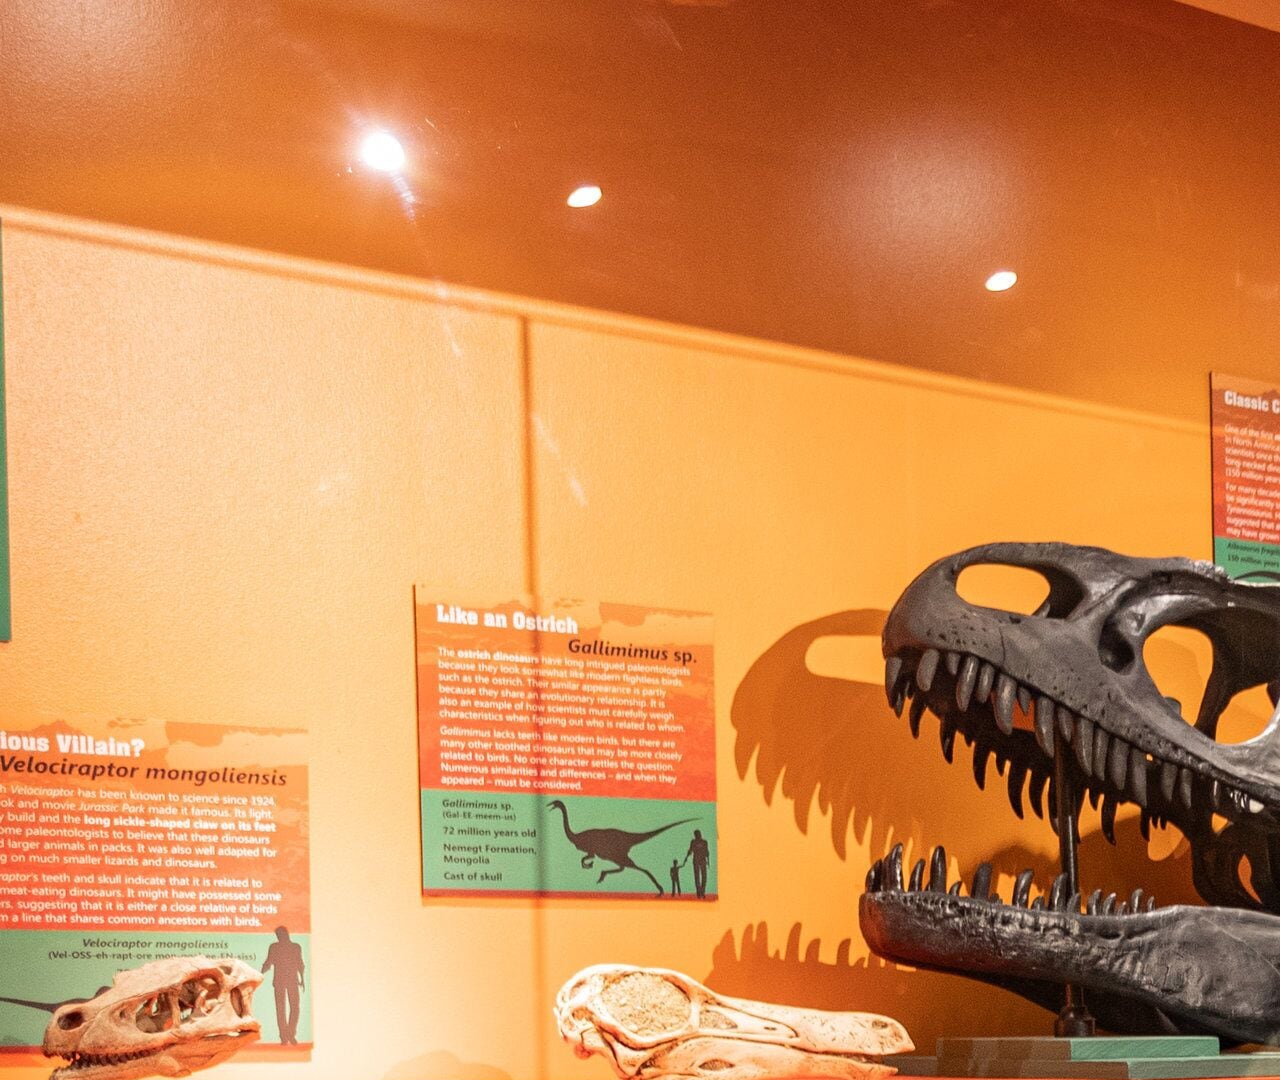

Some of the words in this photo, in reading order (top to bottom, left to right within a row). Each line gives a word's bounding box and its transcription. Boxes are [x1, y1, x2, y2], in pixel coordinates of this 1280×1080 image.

[1224, 390, 1269, 412] Classic
[437, 604, 478, 625] Like
[484, 613, 507, 628] an
[513, 611, 578, 635] Ostrich
[567, 637, 668, 662] Gallimimus
[674, 652, 697, 666] sp.
[56, 734, 145, 757] Villain?
[0, 753, 139, 780] Velociraptor
[146, 767, 287, 786] mongoliensis
[441, 776, 485, 786] appeared
[495, 779, 517, 787] must
[519, 778, 532, 788] be
[533, 781, 582, 790] considered.
[442, 799, 498, 810] Gallimimus
[501, 803, 514, 812] sp.
[443, 826, 455, 835] 72
[458, 827, 491, 836] million
[494, 830, 519, 838] years
[521, 829, 537, 838] old
[443, 844, 482, 854] Nemegt
[485, 844, 537, 856] Formation,
[29, 854, 60, 863] much
[63, 855, 102, 865] smaller
[105, 856, 139, 866] lizards
[142, 857, 162, 867] and
[164, 858, 217, 869] dinosaurs.
[444, 855, 490, 866] Mongolia
[444, 872, 464, 880] Cast
[468, 872, 477, 881] of
[480, 872, 502, 881] skull
[22, 913, 42, 923] line
[45, 913, 67, 923] that
[70, 914, 105, 924] shares
[108, 916, 155, 925] common
[158, 916, 208, 926] ancestors
[210, 917, 232, 926] with
[235, 916, 262, 927] birds.
[83, 938, 153, 950] Velociraptor
[156, 940, 228, 951] mongoliensis
